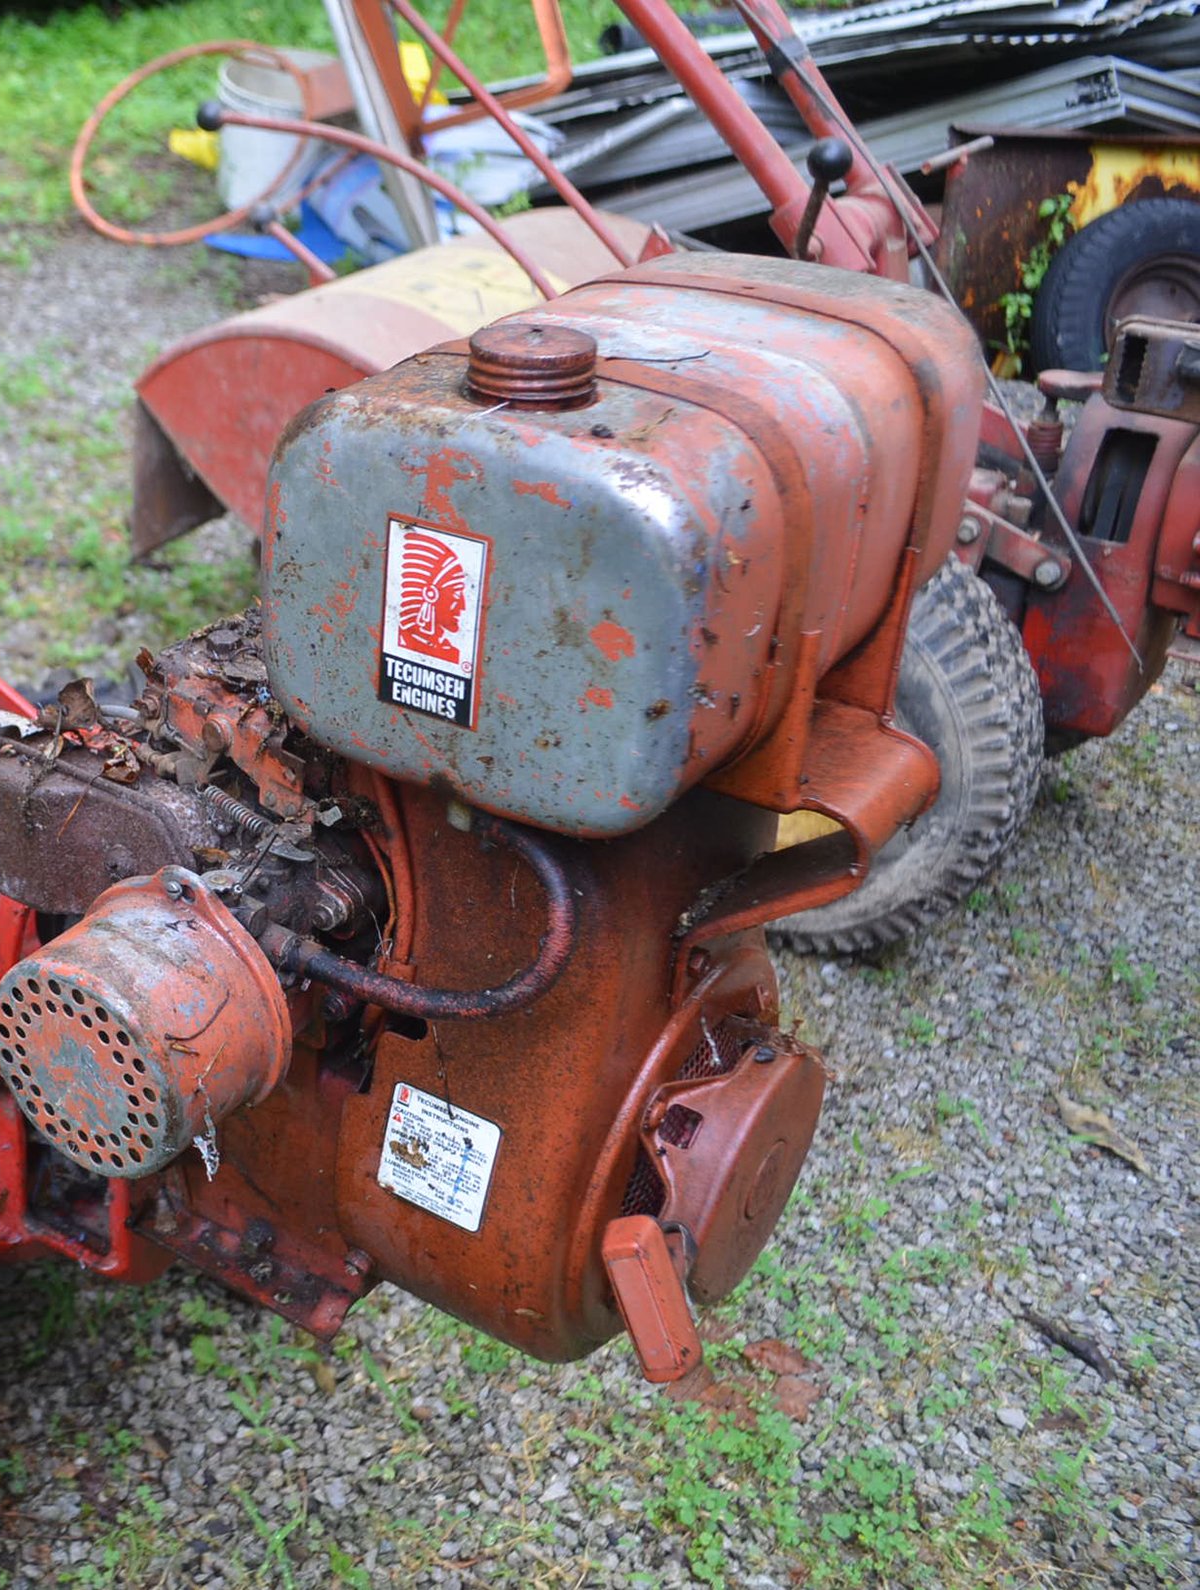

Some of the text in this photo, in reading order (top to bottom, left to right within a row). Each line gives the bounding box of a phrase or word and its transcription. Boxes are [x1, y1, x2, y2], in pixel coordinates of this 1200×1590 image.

[385, 657, 464, 700] TECUMSEH
[392, 681, 456, 719] ENGINES
[416, 1095, 480, 1129] TECUMSE ENGINE
[420, 1108, 469, 1134] INSTRUCTIONS
